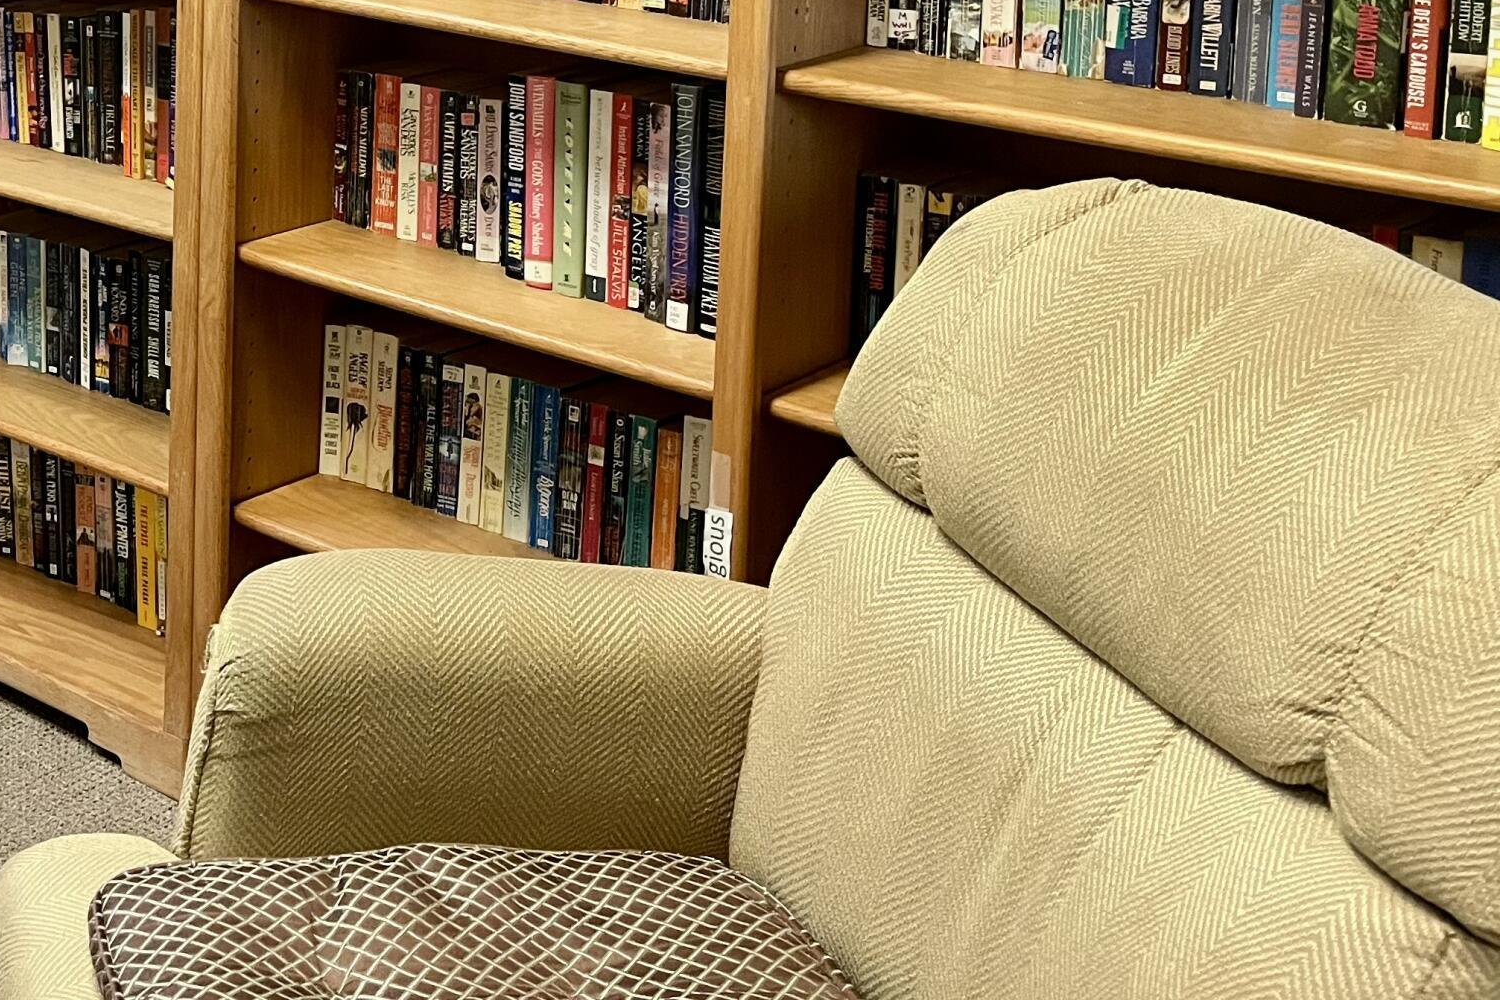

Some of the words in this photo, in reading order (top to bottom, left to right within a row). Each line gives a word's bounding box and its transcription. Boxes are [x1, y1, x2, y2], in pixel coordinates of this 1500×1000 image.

[1305, 12, 1317, 71] JEANNETTE
[509, 83, 525, 105] JOHN
[1302, 75, 1313, 106] WALLS
[1407, 51, 1428, 108] CAROUSEL
[676, 93, 694, 130] JOHN
[509, 108, 524, 171] SANDFORD
[563, 118, 574, 216] LOVELY
[674, 133, 693, 208] SANDFORD
[508, 200, 522, 234] SHADOW
[613, 219, 623, 245] JILL
[508, 235, 522, 261] PREY
[632, 217, 642, 282] ANGELS
[148, 274, 160, 294] SARA
[612, 248, 623, 300] SHALVIS
[147, 296, 160, 334] PARETSKY
[116, 490, 128, 520] JASON
[117, 521, 129, 559] PINTER
